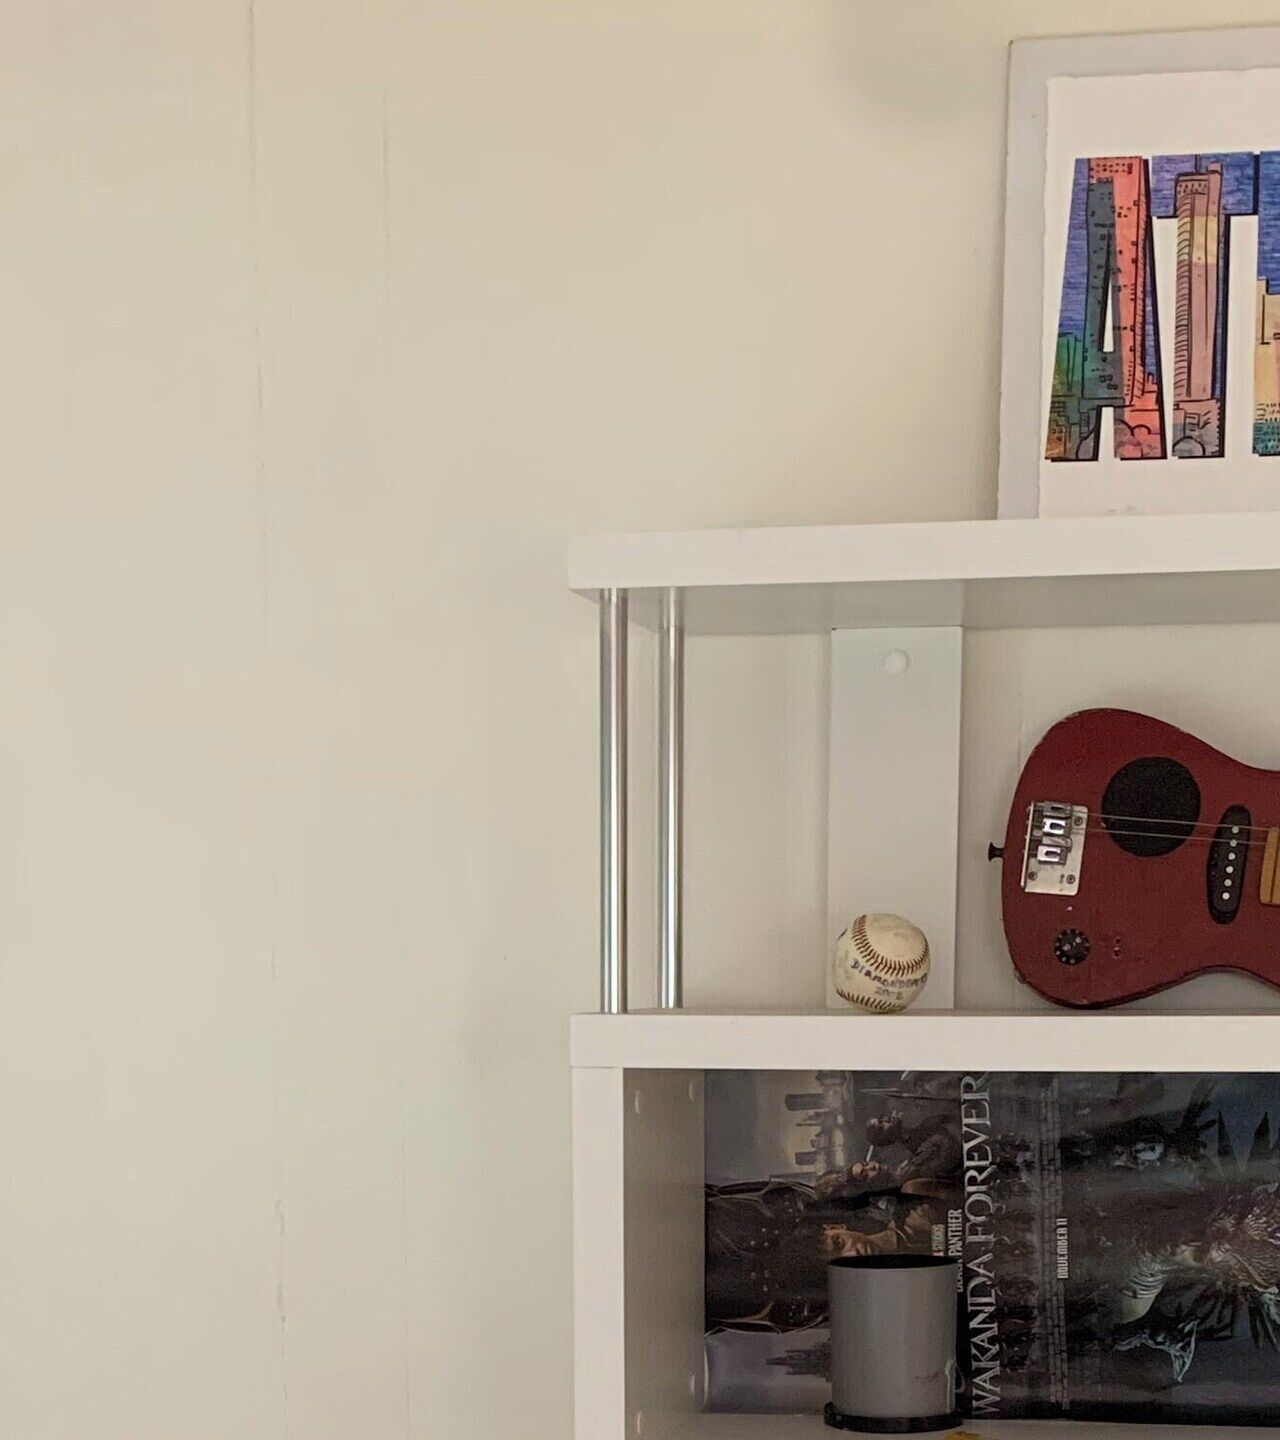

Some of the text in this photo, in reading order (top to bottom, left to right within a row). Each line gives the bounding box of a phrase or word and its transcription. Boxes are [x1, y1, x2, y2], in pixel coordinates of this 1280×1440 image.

[947, 1209, 963, 1256] PANTHER
[961, 1073, 1000, 1415] WAKANDA FOREVER
[1056, 1227, 1068, 1279] NOVEMBER
